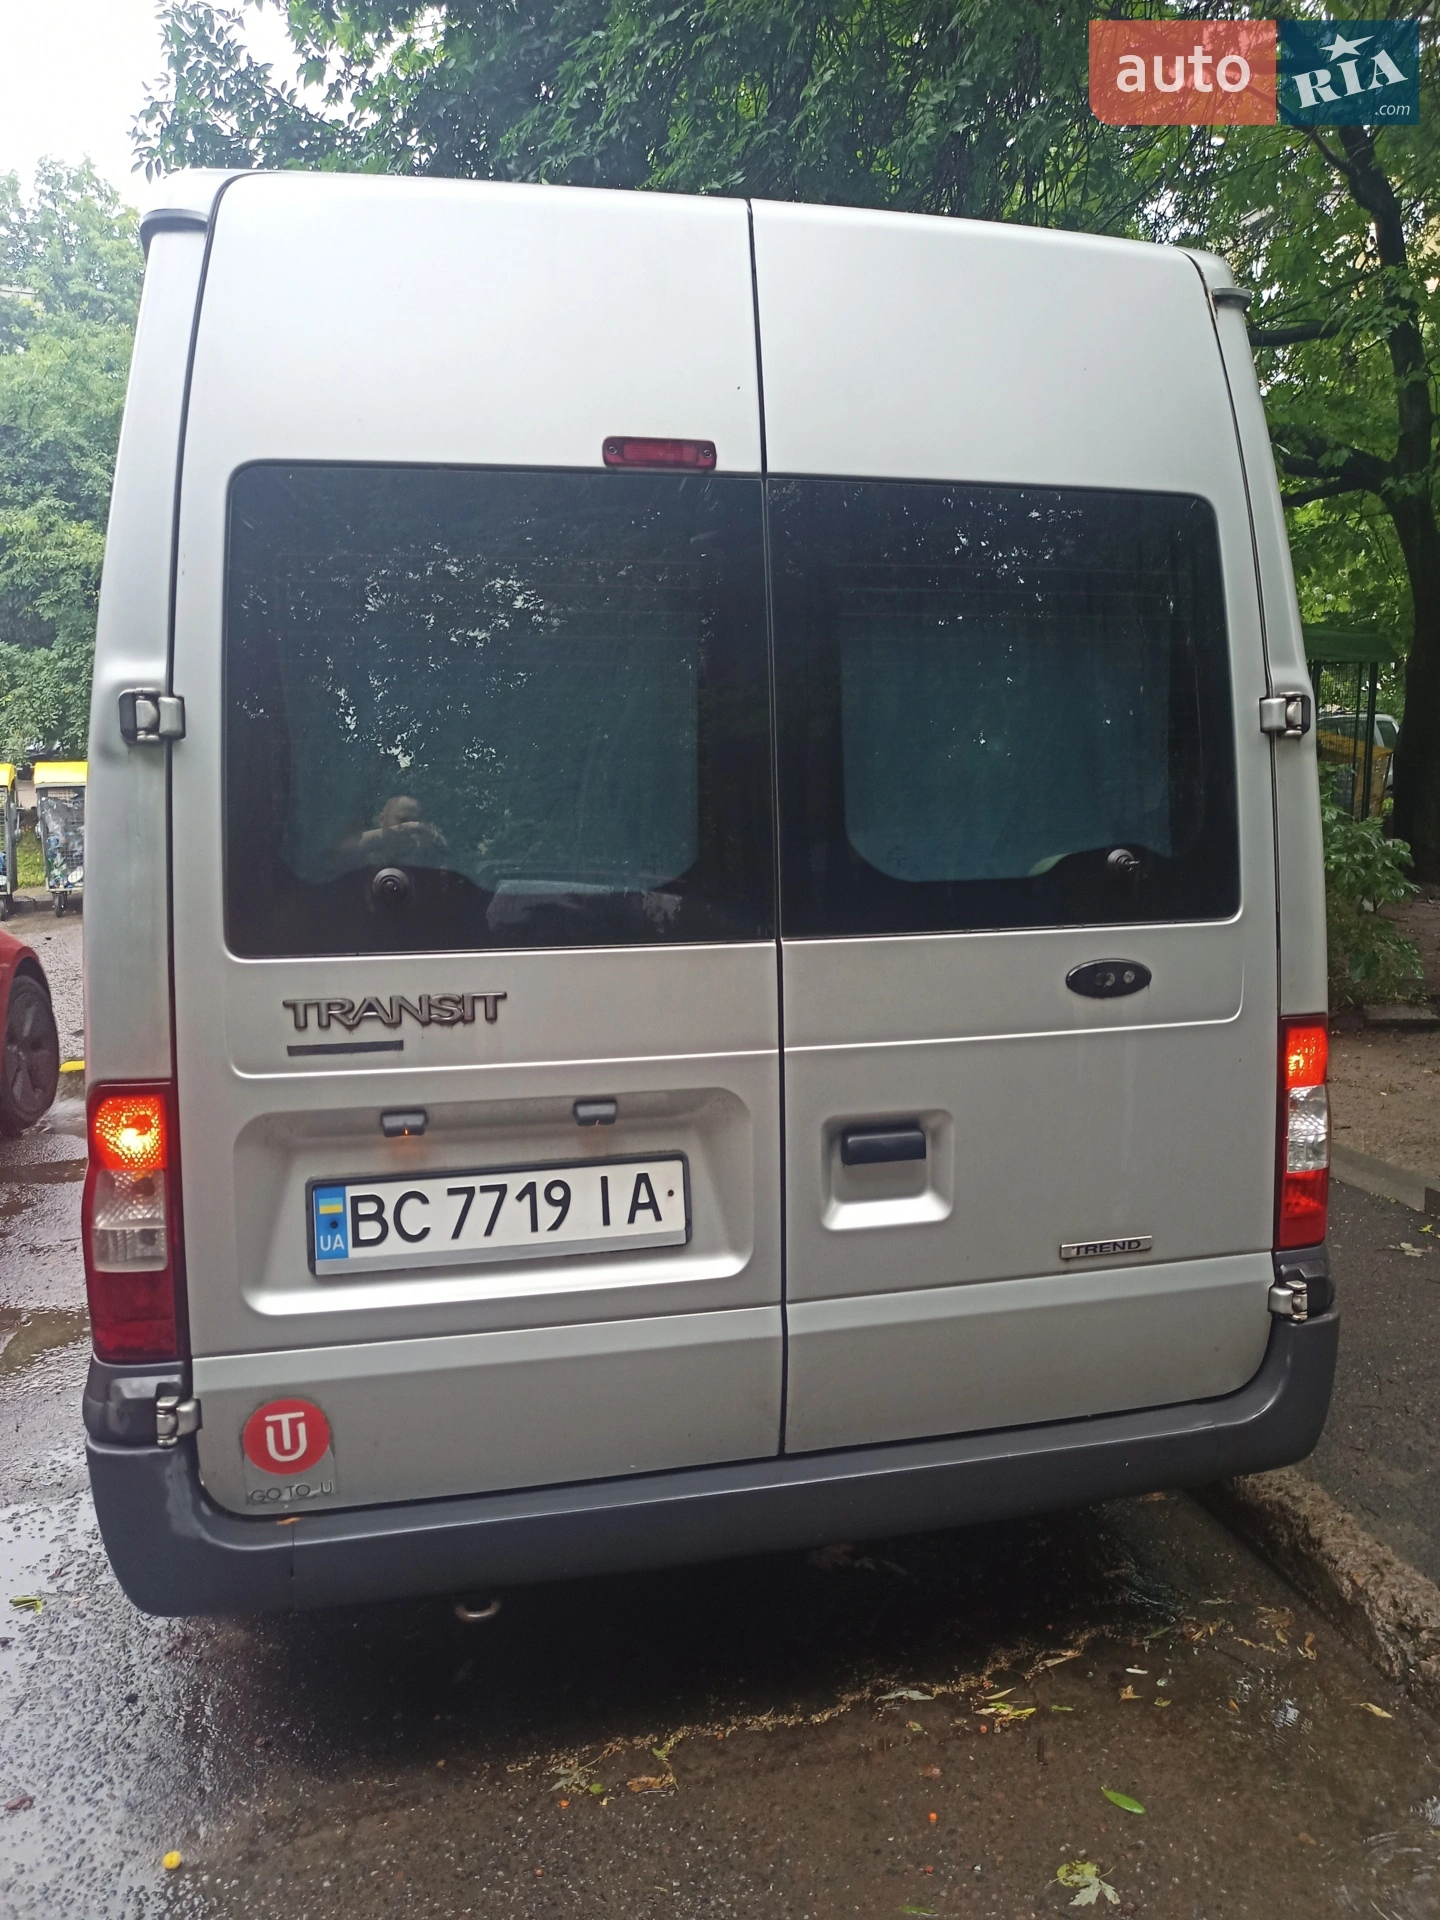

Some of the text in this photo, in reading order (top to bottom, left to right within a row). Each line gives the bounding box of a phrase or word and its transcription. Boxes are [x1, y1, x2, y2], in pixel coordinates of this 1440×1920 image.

[283, 992, 507, 1030] TRANSIT
[350, 1172, 662, 1249] BC 7719 IA
[320, 1234, 345, 1251] UA
[1073, 1240, 1141, 1255] TREND
[251, 1489, 282, 1501] GO
[286, 1484, 310, 1498] TO
